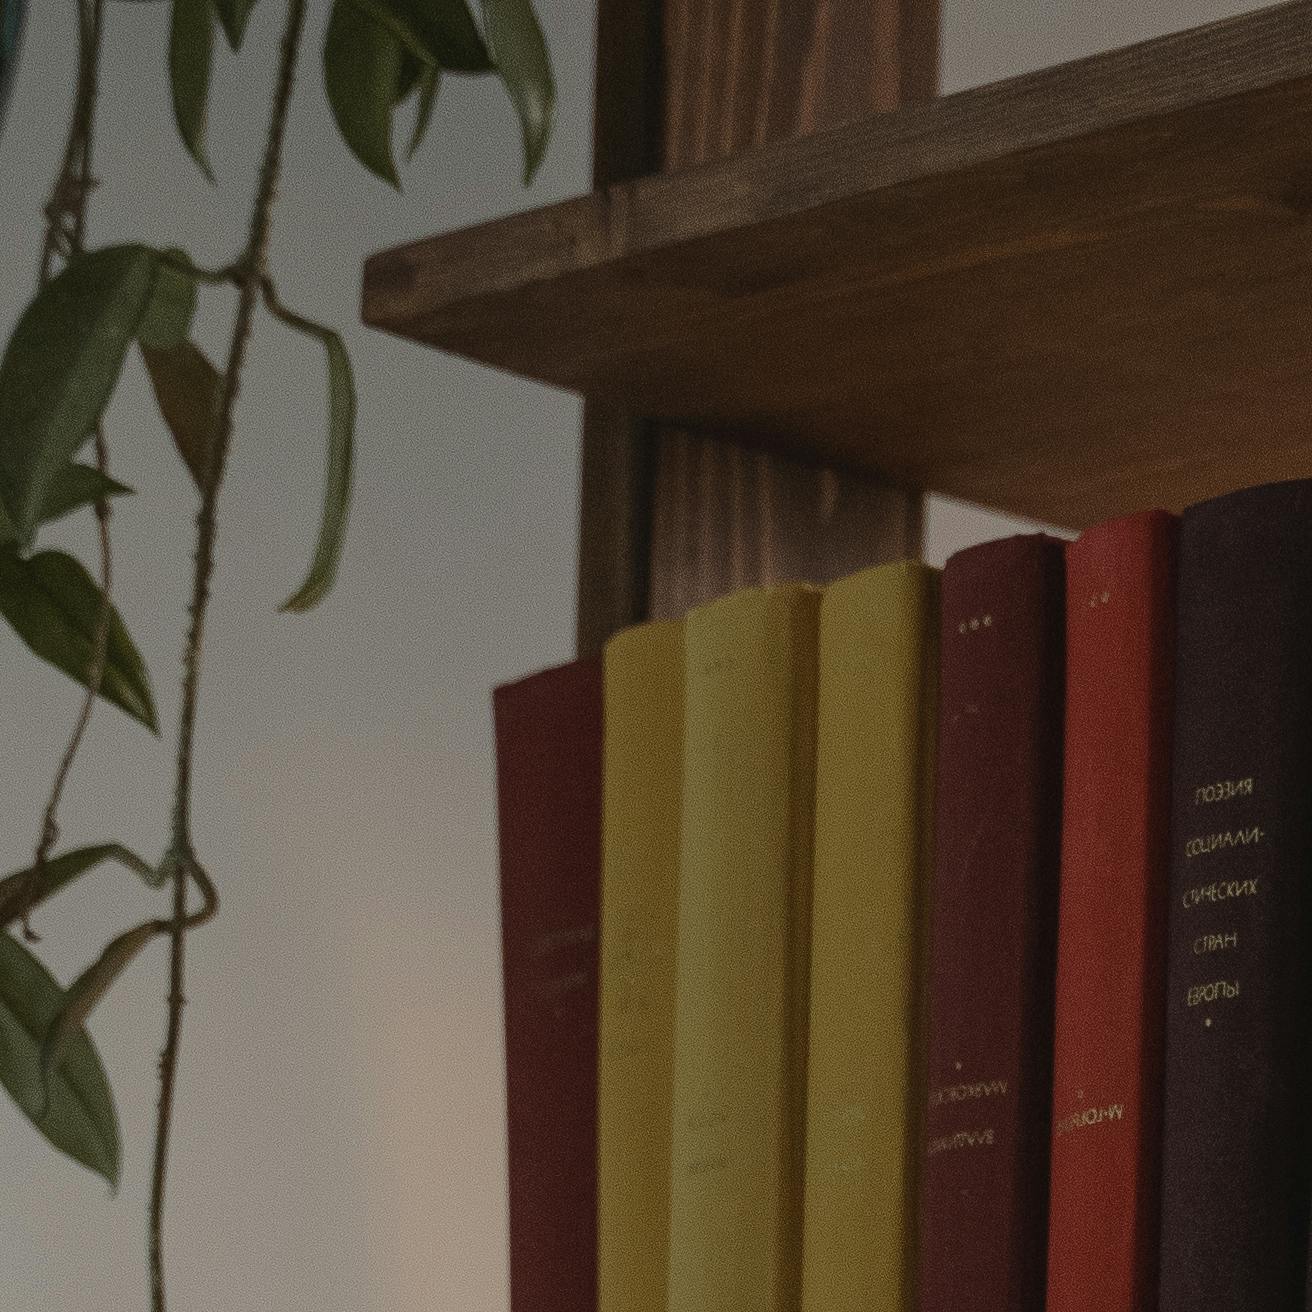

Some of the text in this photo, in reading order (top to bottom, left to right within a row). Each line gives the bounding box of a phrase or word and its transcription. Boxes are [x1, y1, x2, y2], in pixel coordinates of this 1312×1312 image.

[1194, 777, 1254, 804] ПОЭЗИЯ
[1185, 826, 1265, 858] СОЦИАЛИ-
[1182, 876, 1260, 909] СТИЧЕСКИХ
[1193, 932, 1238, 955] СТРАН
[1187, 980, 1241, 1006] ЕВРОПЫ
[927, 1080, 1008, 1107] МАЯКОВСК
[927, 1128, 995, 1157] ВЛАДИМ
